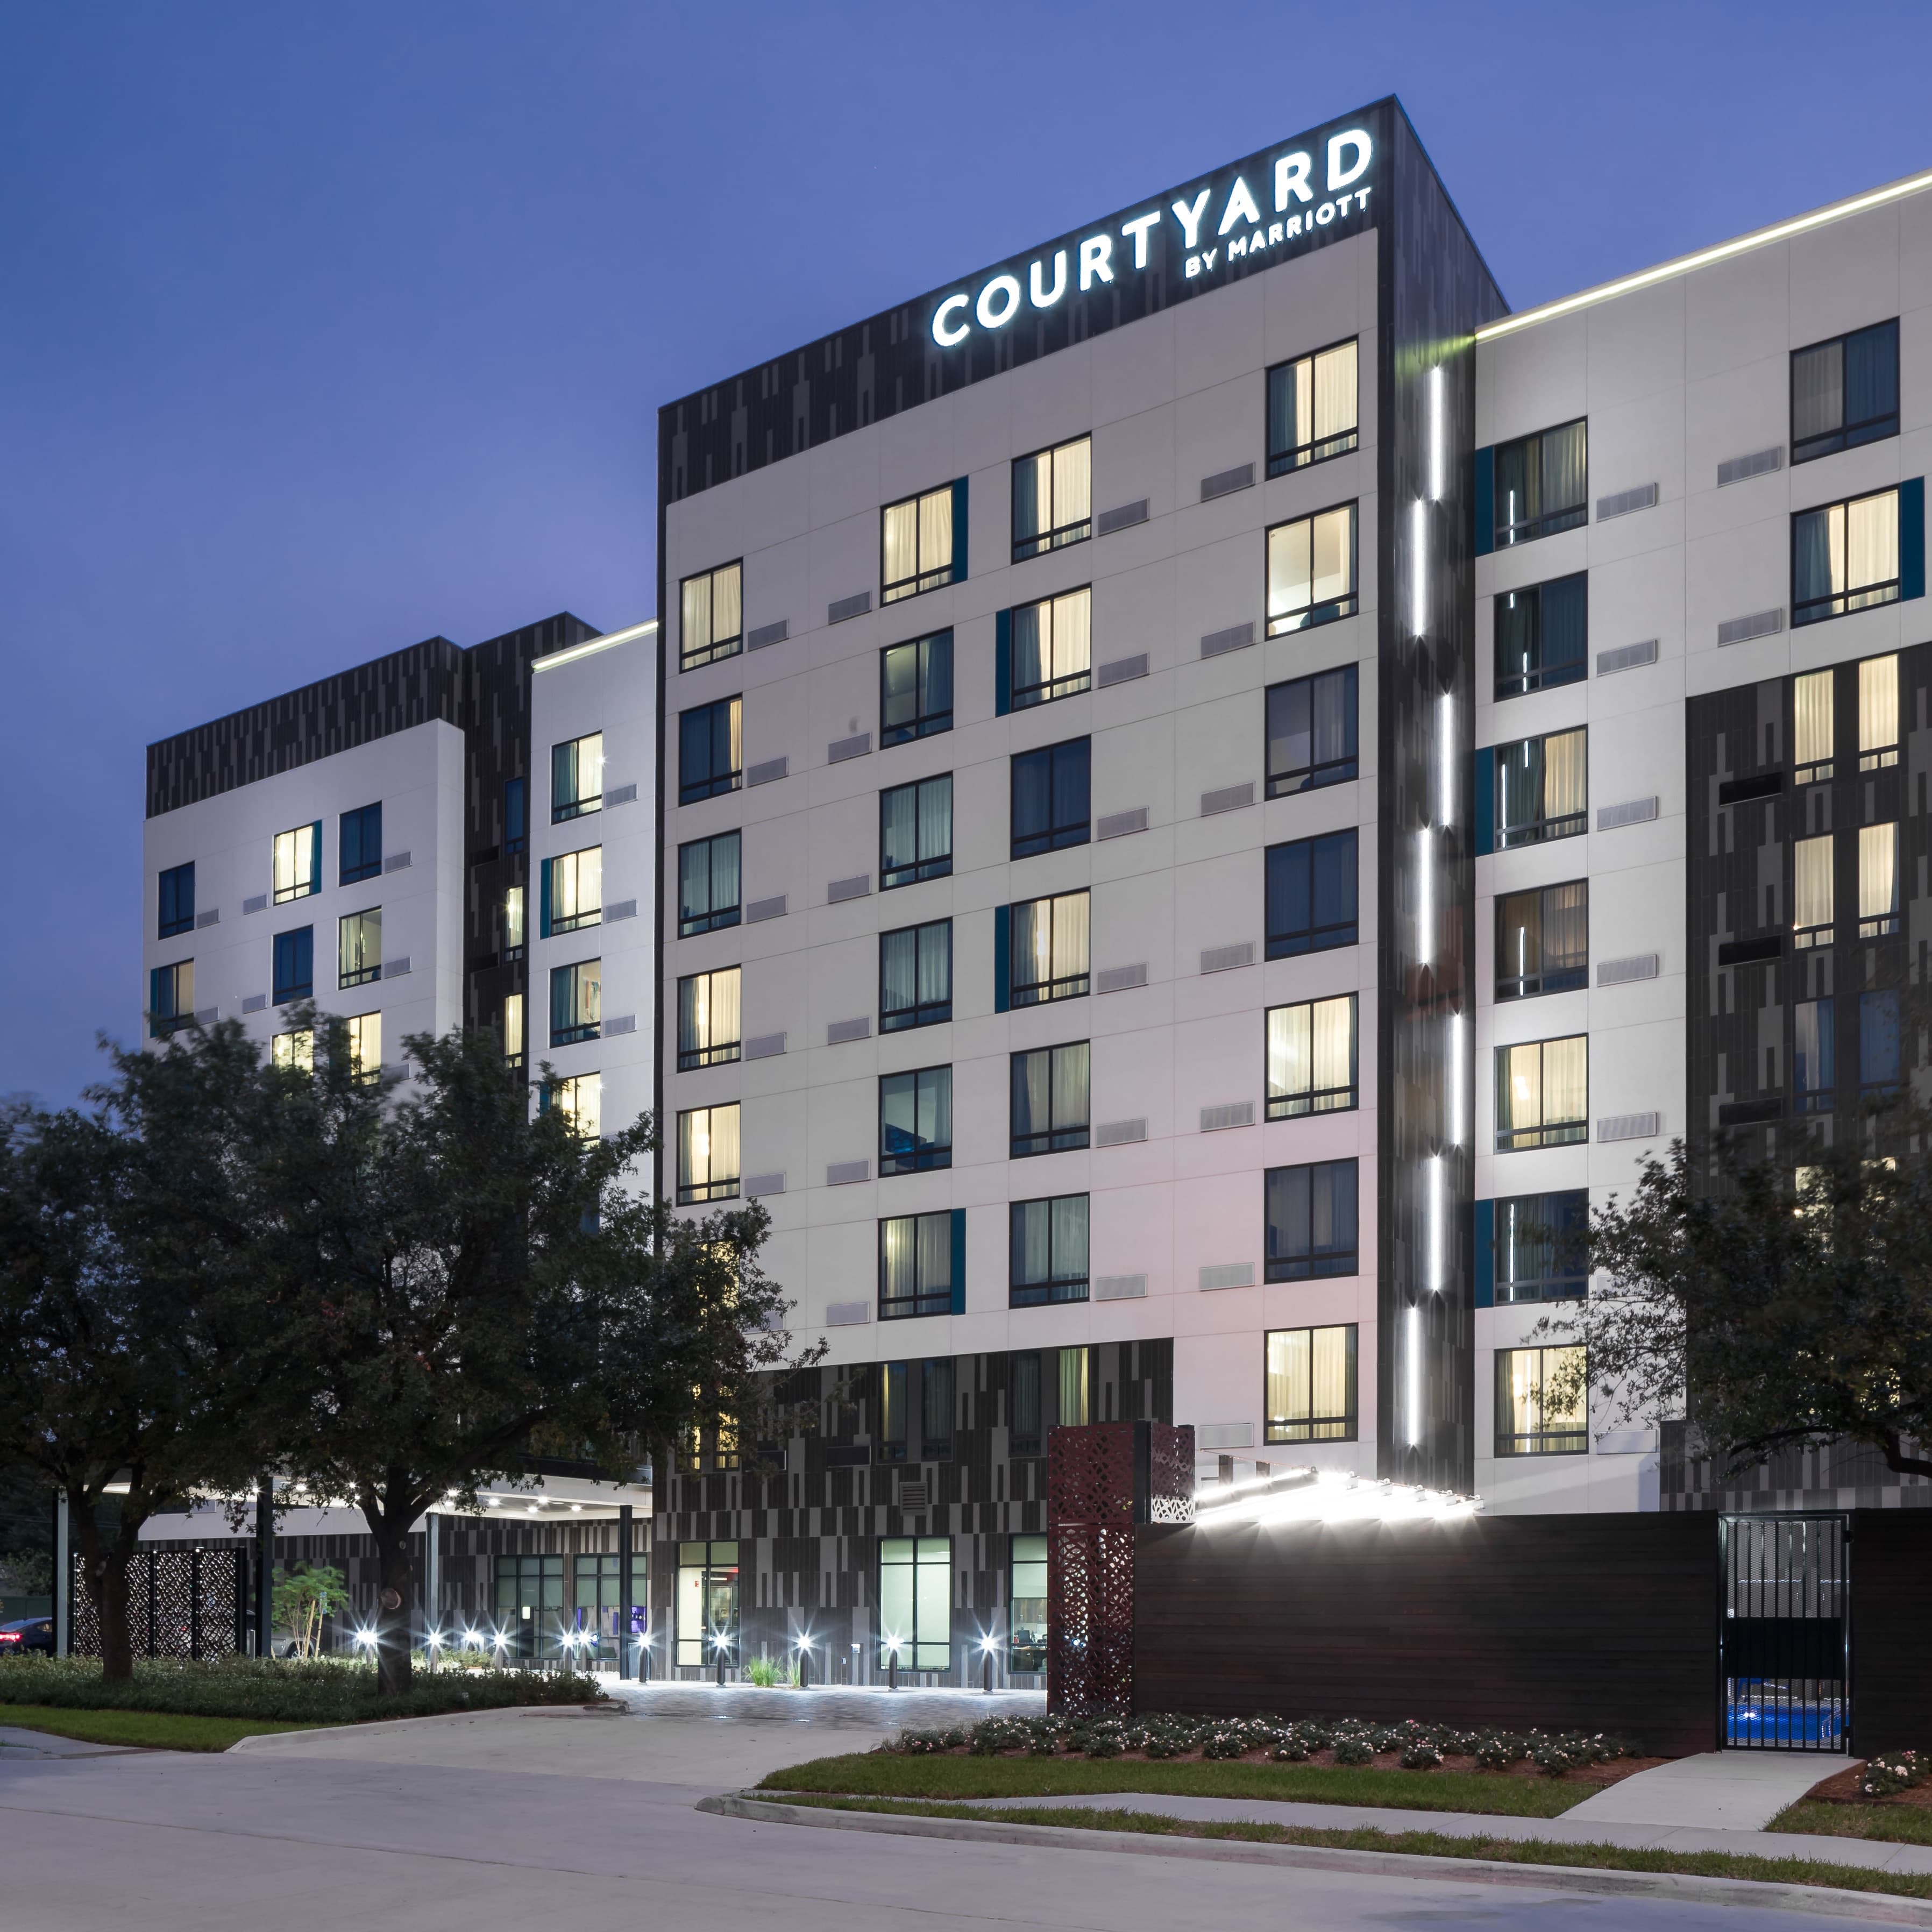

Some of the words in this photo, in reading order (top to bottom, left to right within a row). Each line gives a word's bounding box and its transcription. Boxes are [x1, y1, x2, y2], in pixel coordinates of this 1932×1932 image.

[932, 129, 1373, 347] COURTYARD
[1185, 247, 1218, 279] BY
[1227, 186, 1372, 262] MARRIOTT
